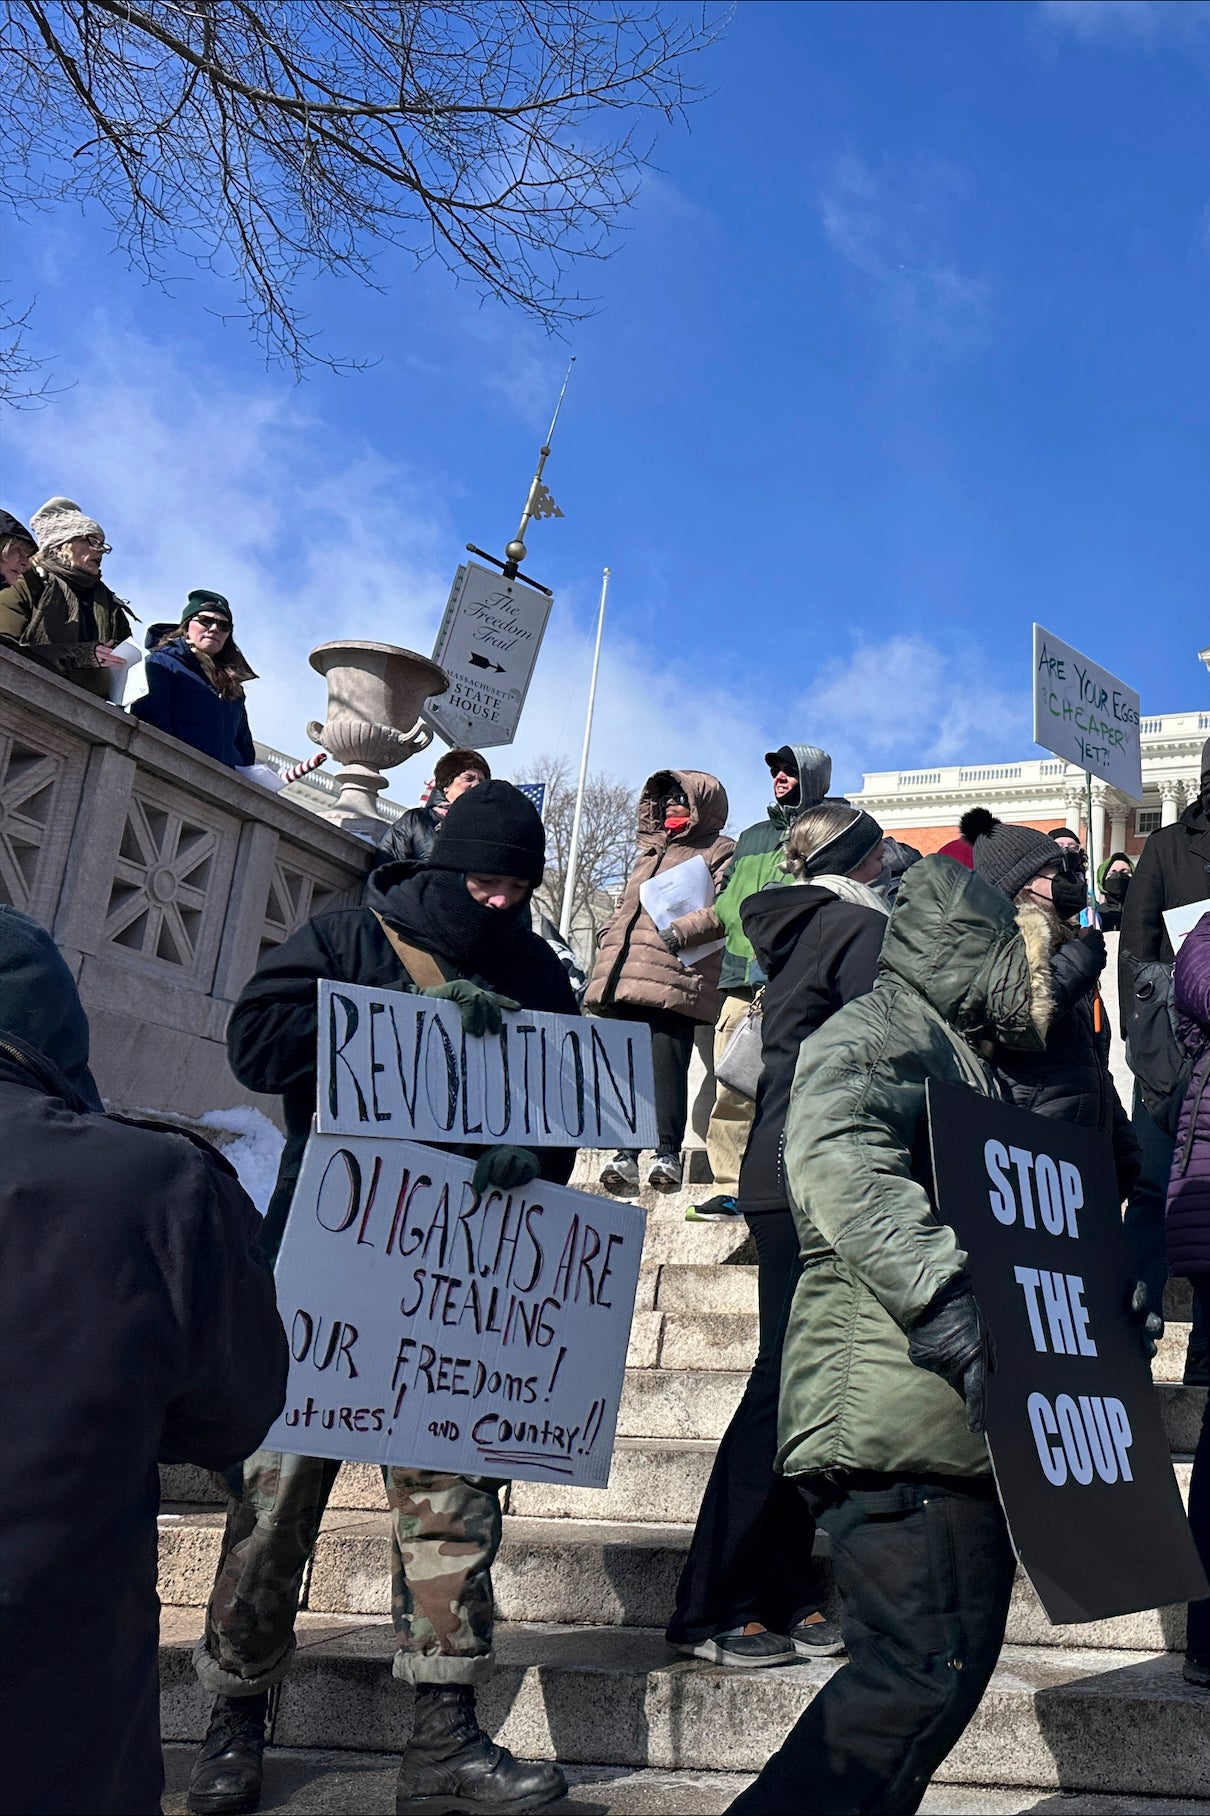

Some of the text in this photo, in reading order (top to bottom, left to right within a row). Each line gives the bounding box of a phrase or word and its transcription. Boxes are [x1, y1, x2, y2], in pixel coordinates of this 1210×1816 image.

[463, 601, 535, 641] Freedom
[472, 625, 515, 652] Trail
[485, 592, 520, 617] The
[449, 694, 501, 723] HOUSE
[453, 683, 503, 710] STATE
[1038, 643, 1140, 726] ARE YOUR EGGS
[1074, 736, 1110, 767] YET?!
[329, 991, 638, 1138] REVOLUTION
[983, 1138, 1085, 1240] STOP
[315, 1148, 624, 1309] OLIGARCHS ARE
[291, 1308, 359, 1379] OUR
[400, 1268, 563, 1348] STEALING
[1013, 1265, 1098, 1358] THE
[1026, 1391, 1134, 1487] COUP
